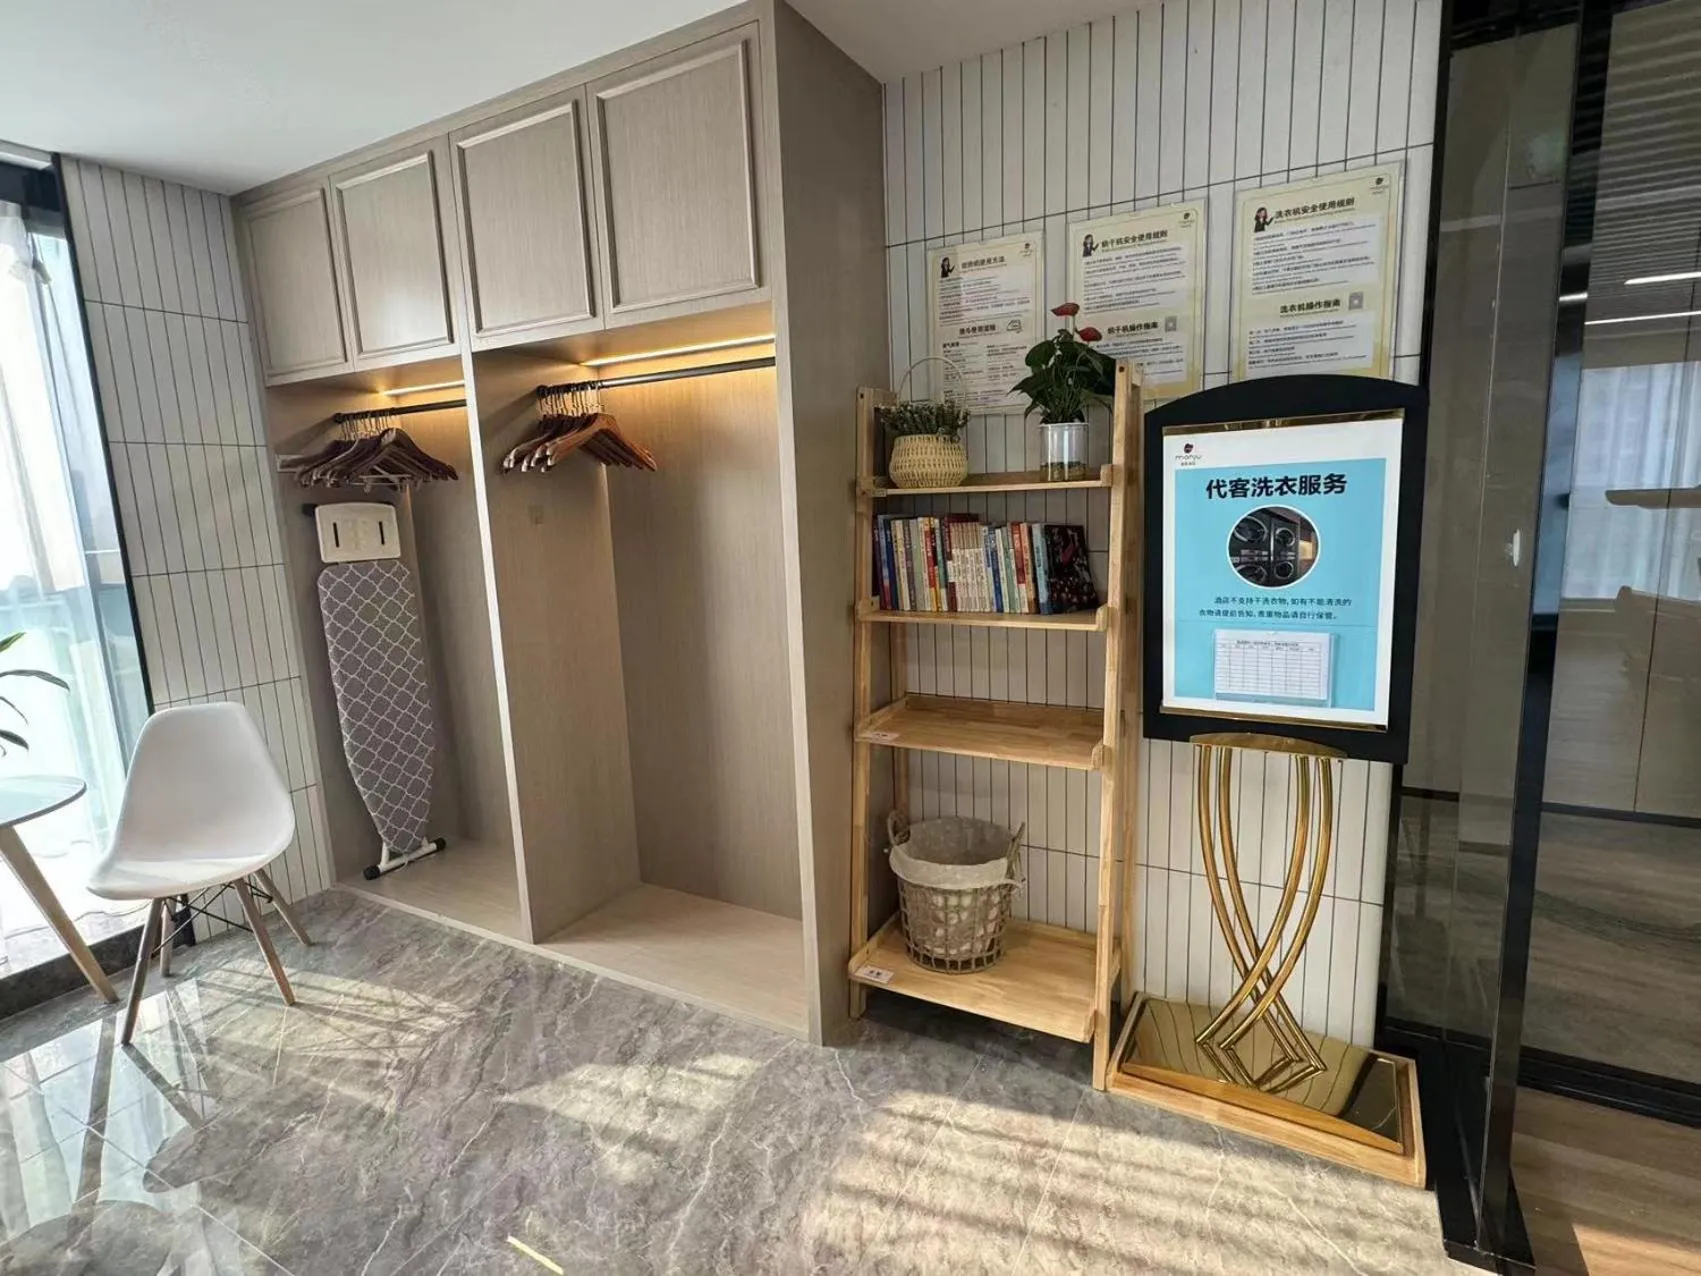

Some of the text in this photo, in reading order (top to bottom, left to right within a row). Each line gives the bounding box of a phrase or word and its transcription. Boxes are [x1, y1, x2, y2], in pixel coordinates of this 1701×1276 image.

[1274, 197, 1355, 219] 洗衣机安全使用规则
[1279, 299, 1341, 313] 洗衣机操作指南
[1206, 472, 1348, 499] 代客洗衣服务
